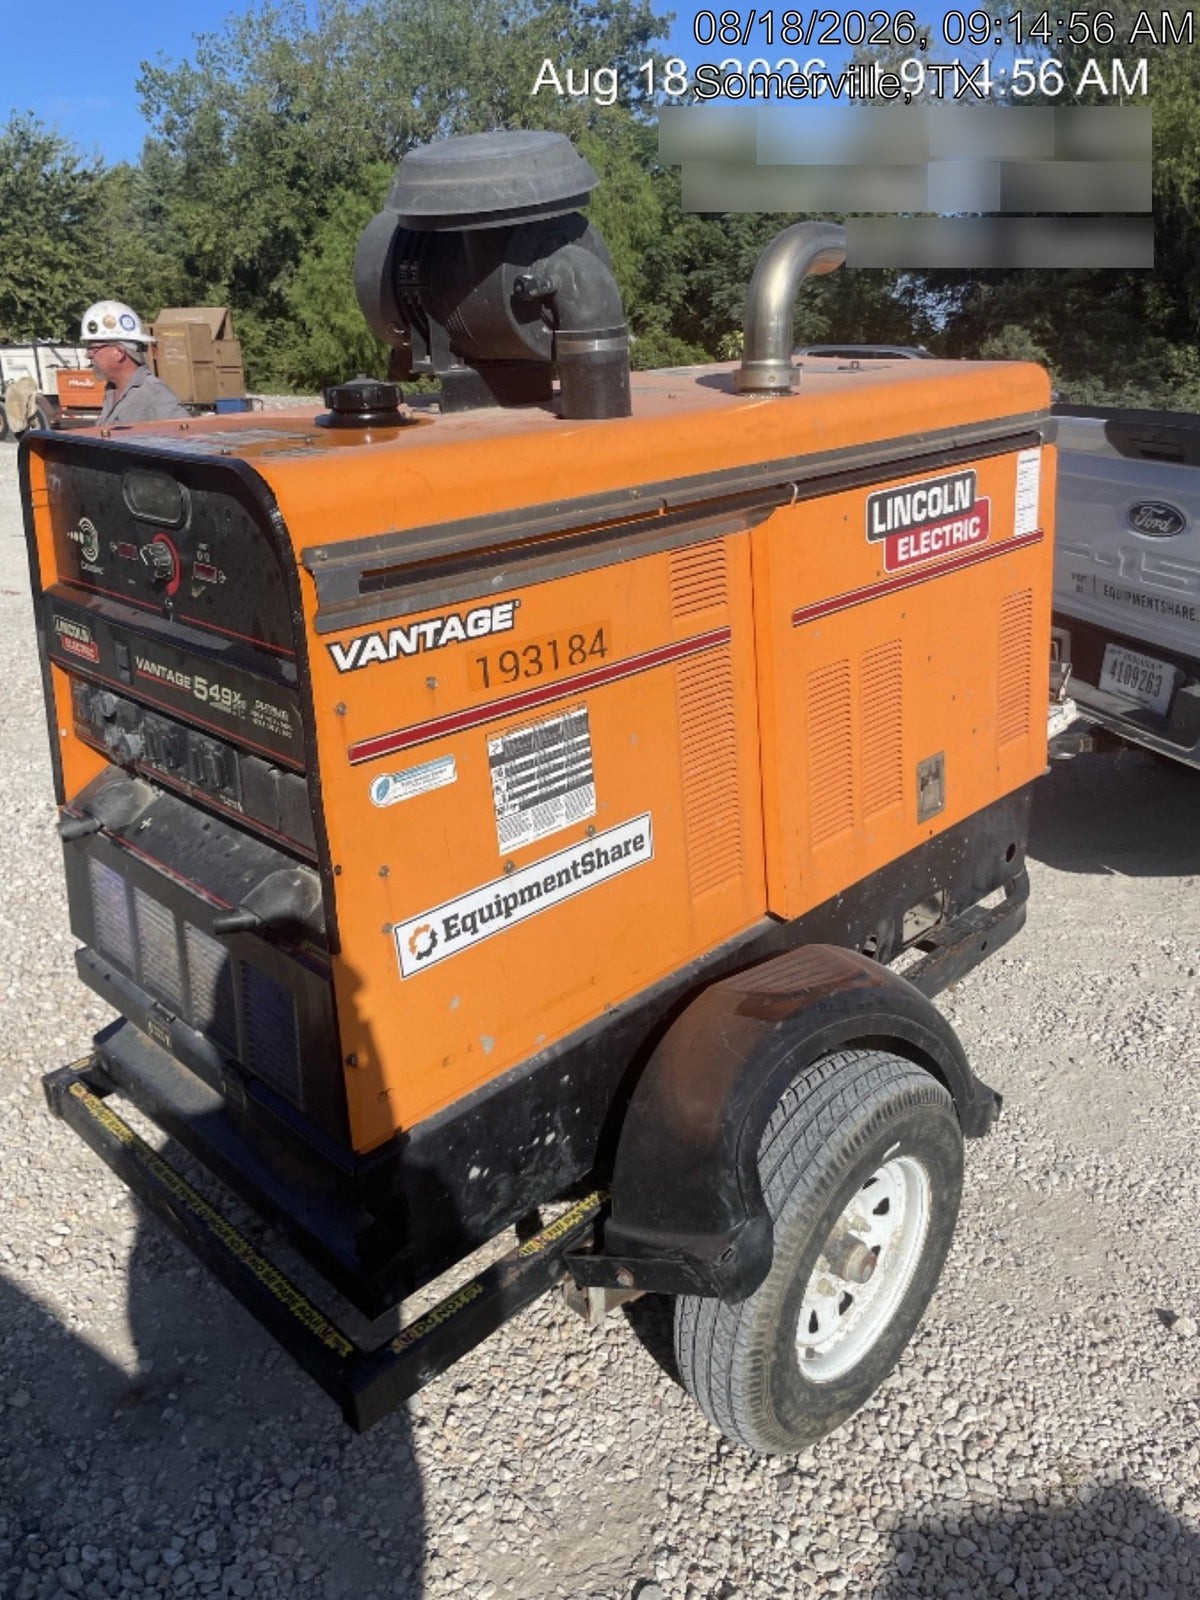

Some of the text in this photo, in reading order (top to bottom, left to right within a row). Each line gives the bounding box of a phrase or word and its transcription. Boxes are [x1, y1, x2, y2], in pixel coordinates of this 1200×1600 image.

[872, 478, 972, 534] LINCOLN
[1134, 505, 1175, 532] Ford
[897, 516, 981, 562] ELECTRIC
[328, 600, 518, 672] VANTAGE
[475, 627, 609, 690] 193184
[135, 655, 191, 689] VANTAGE
[442, 831, 646, 943] EquipmentShare
